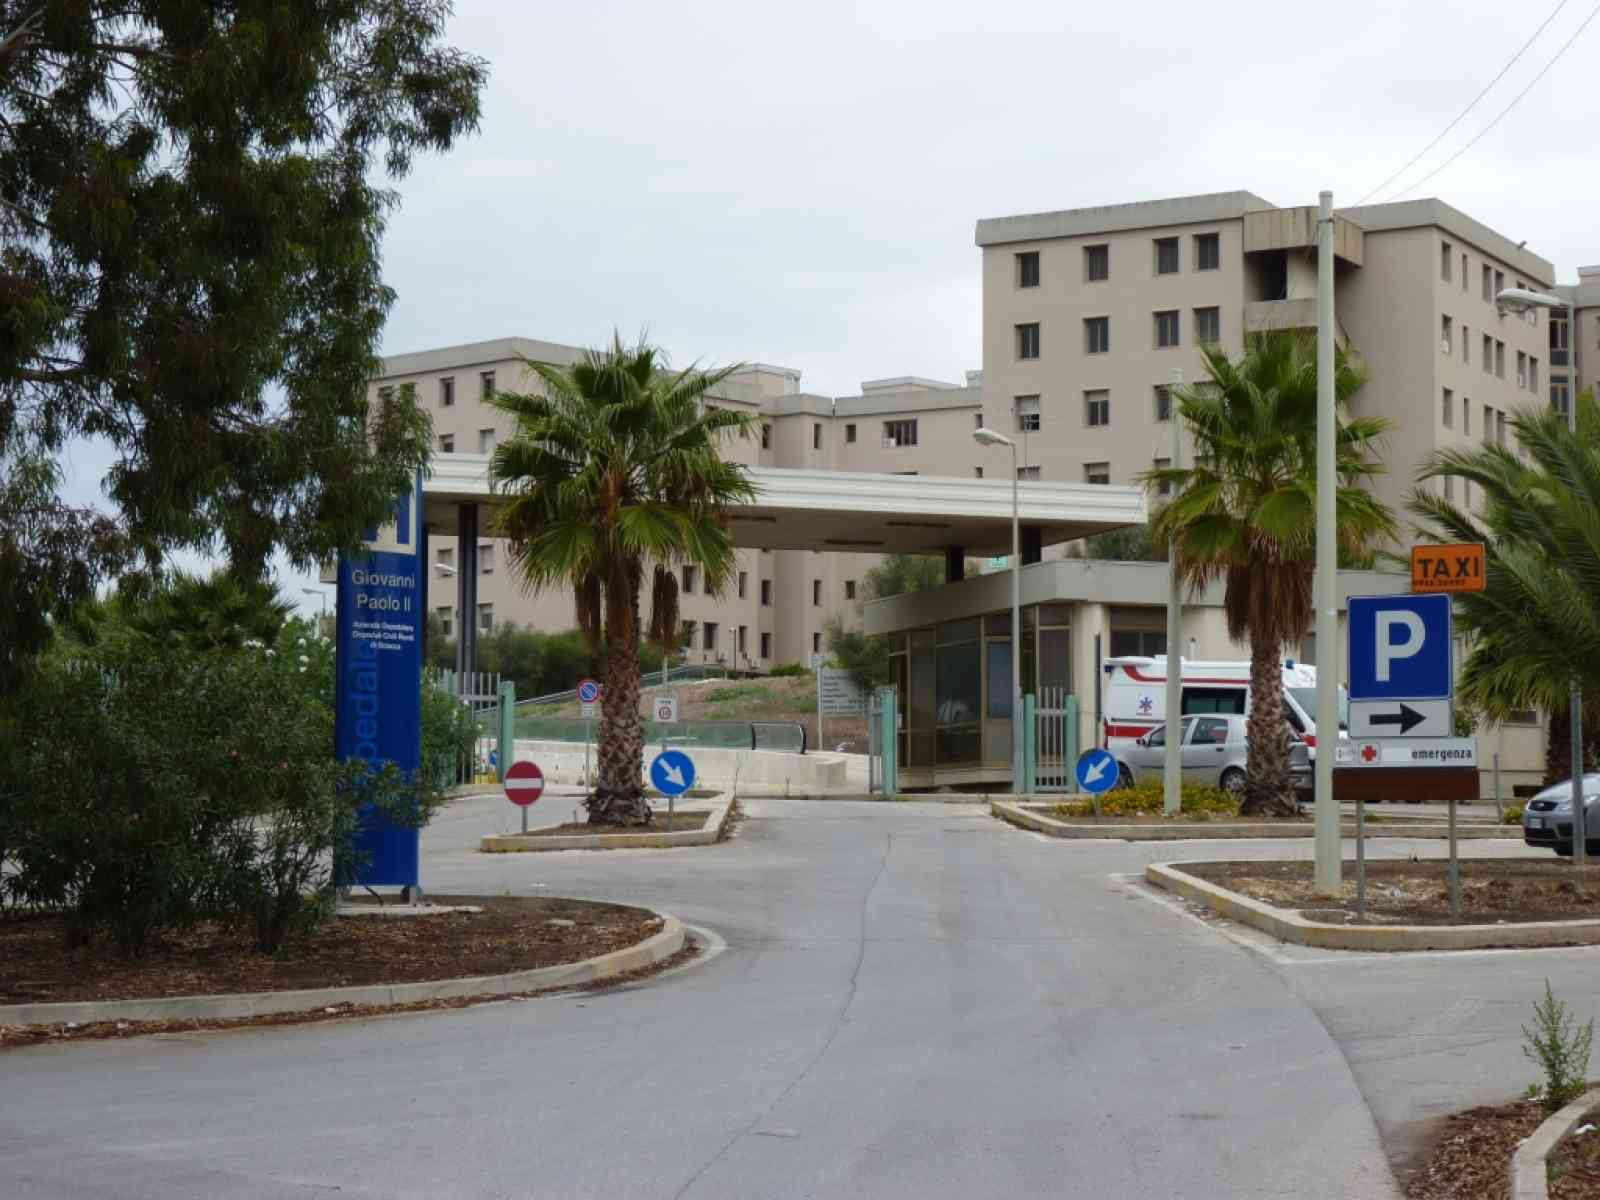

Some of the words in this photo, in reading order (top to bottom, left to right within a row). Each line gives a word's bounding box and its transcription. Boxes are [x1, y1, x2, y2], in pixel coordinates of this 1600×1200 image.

[1417, 556, 1480, 578] TAXI
[351, 569, 415, 588] Giovanni
[356, 594, 400, 611] Paolo
[1375, 610, 1426, 682] P
[1411, 748, 1472, 761] emergenza
